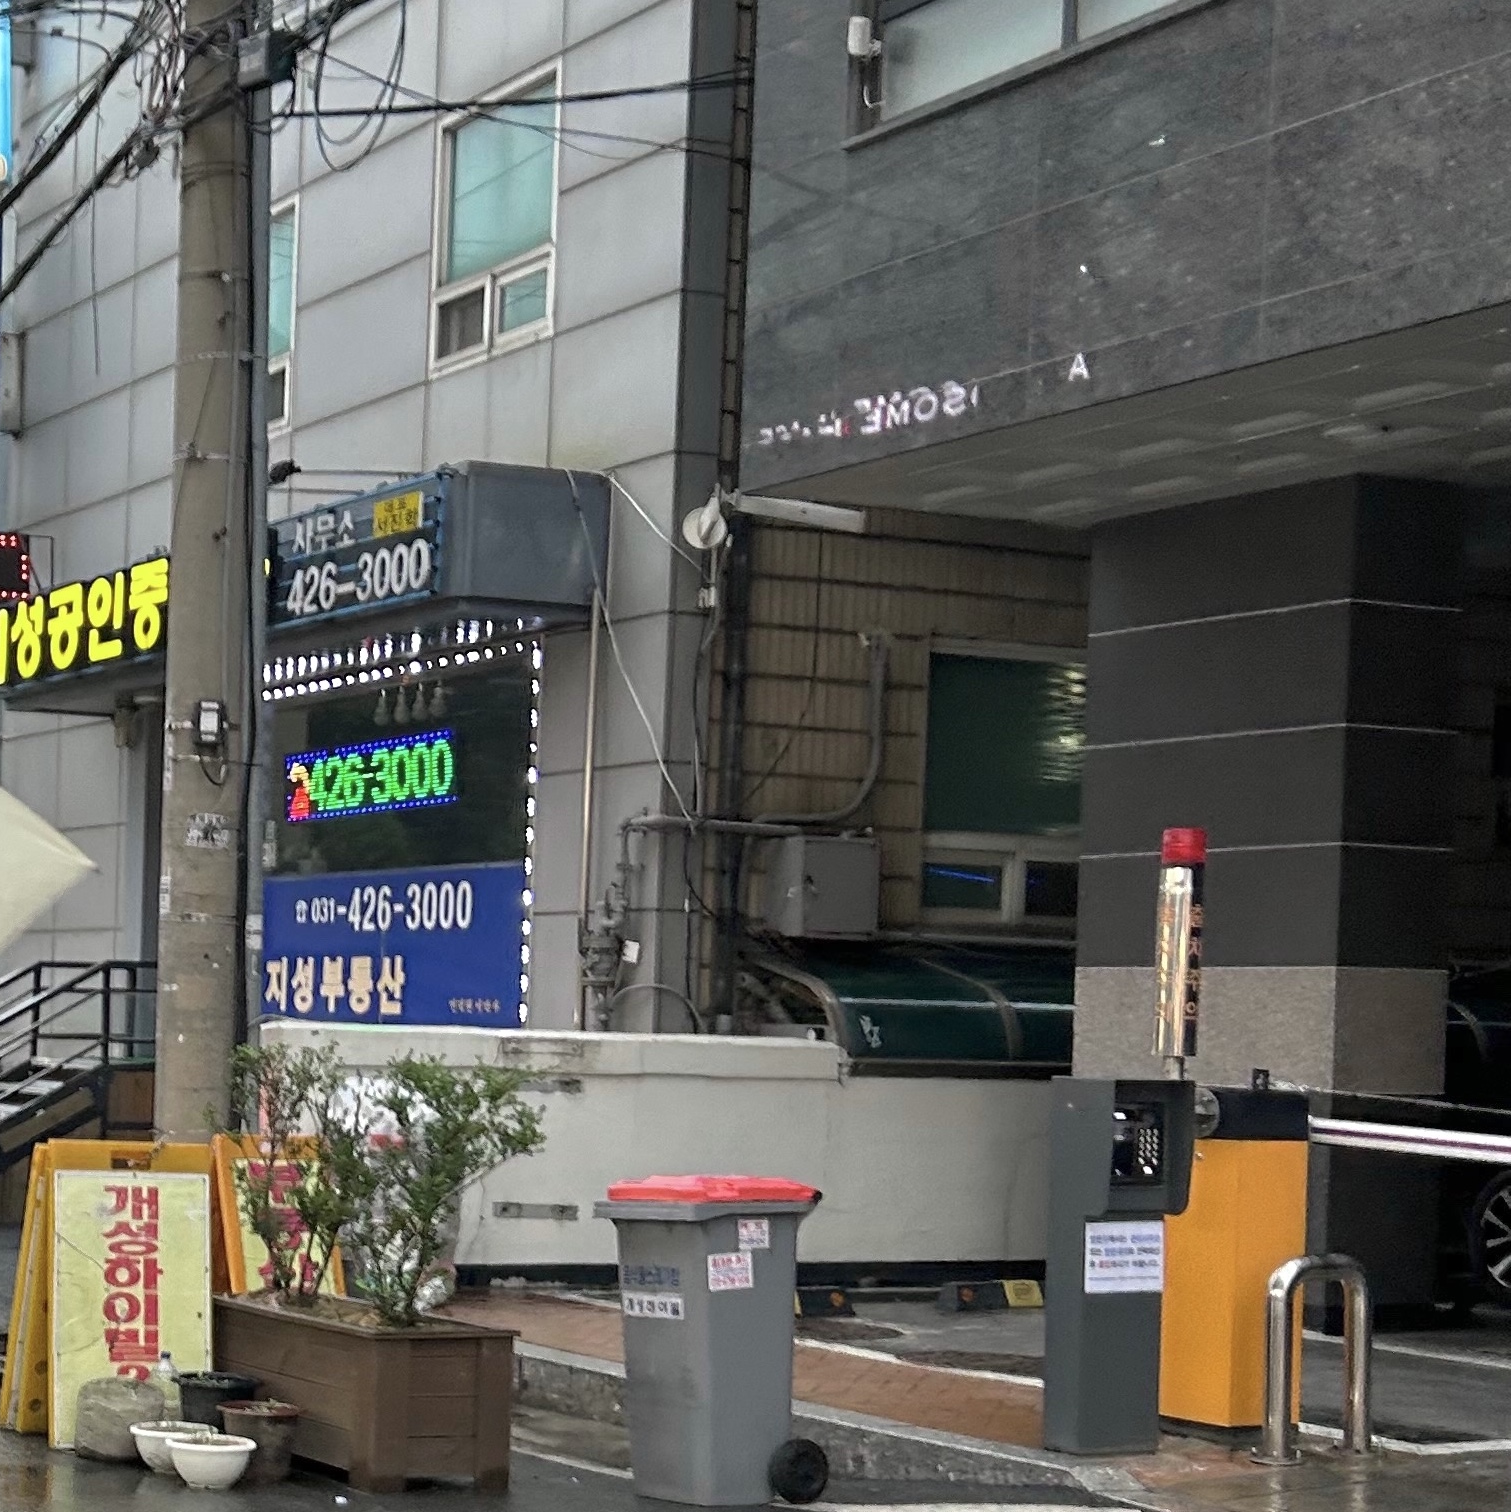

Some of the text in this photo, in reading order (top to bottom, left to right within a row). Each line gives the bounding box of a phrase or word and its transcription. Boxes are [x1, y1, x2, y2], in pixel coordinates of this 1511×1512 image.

[291, 510, 357, 556] 사무소
[286, 537, 432, 616] 426-3000
[309, 738, 454, 811] 426-3000
[310, 879, 474, 932] 031-426-3000
[264, 953, 406, 1015] 지성부동산
